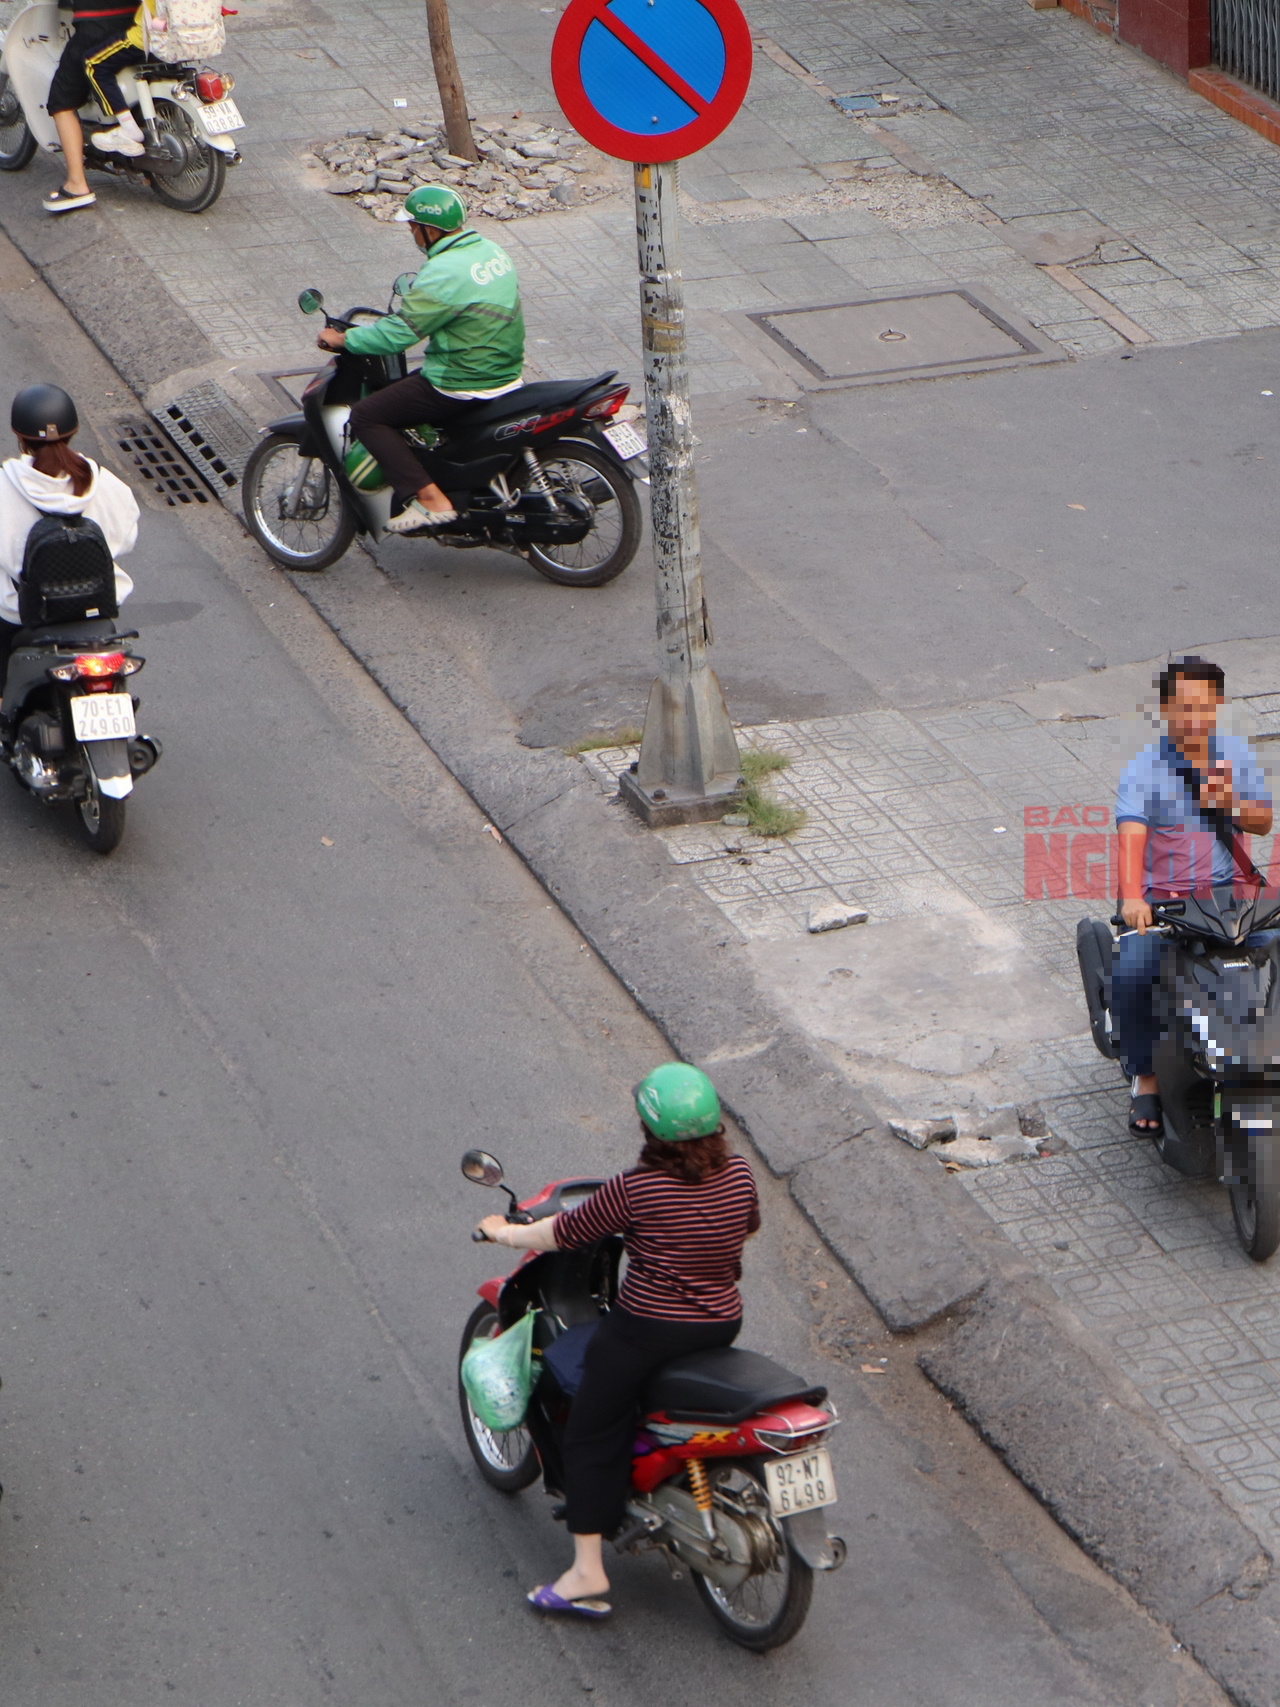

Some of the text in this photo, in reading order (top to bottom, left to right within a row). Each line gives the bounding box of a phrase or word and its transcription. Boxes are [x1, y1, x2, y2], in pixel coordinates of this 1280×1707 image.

[203, 102, 233, 119] 59-VA
[415, 203, 443, 216] Grab
[470, 249, 512, 286] Grab
[81, 698, 123, 718] 70-E1
[79, 716, 131, 737] 249.60
[776, 1455, 818, 1486] 92-N7
